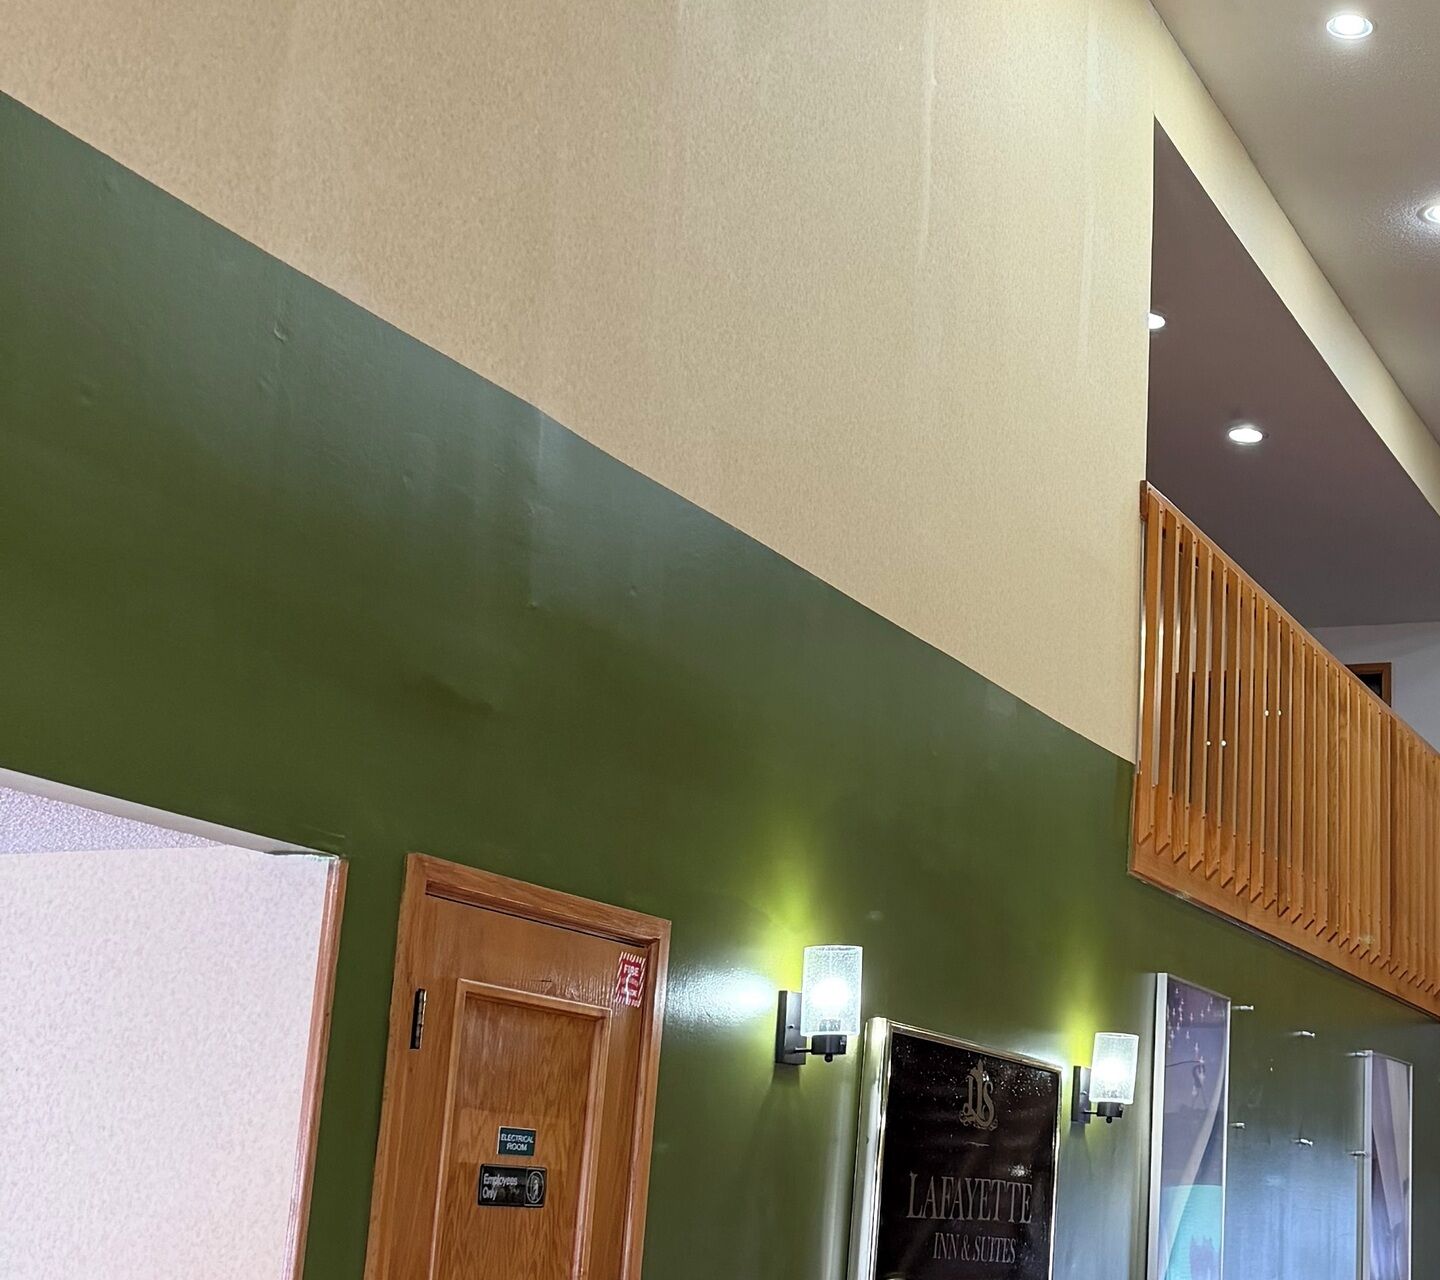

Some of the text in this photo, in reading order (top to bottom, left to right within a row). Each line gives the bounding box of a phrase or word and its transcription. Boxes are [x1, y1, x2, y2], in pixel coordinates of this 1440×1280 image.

[501, 1133, 534, 1143] ELECTRICAL
[506, 1143, 528, 1151] ROOM
[483, 1173, 518, 1187] Employees
[482, 1187, 498, 1200] Only
[906, 1171, 1033, 1224] LAFAYETTE
[933, 1231, 1016, 1263] INN & SUITES
